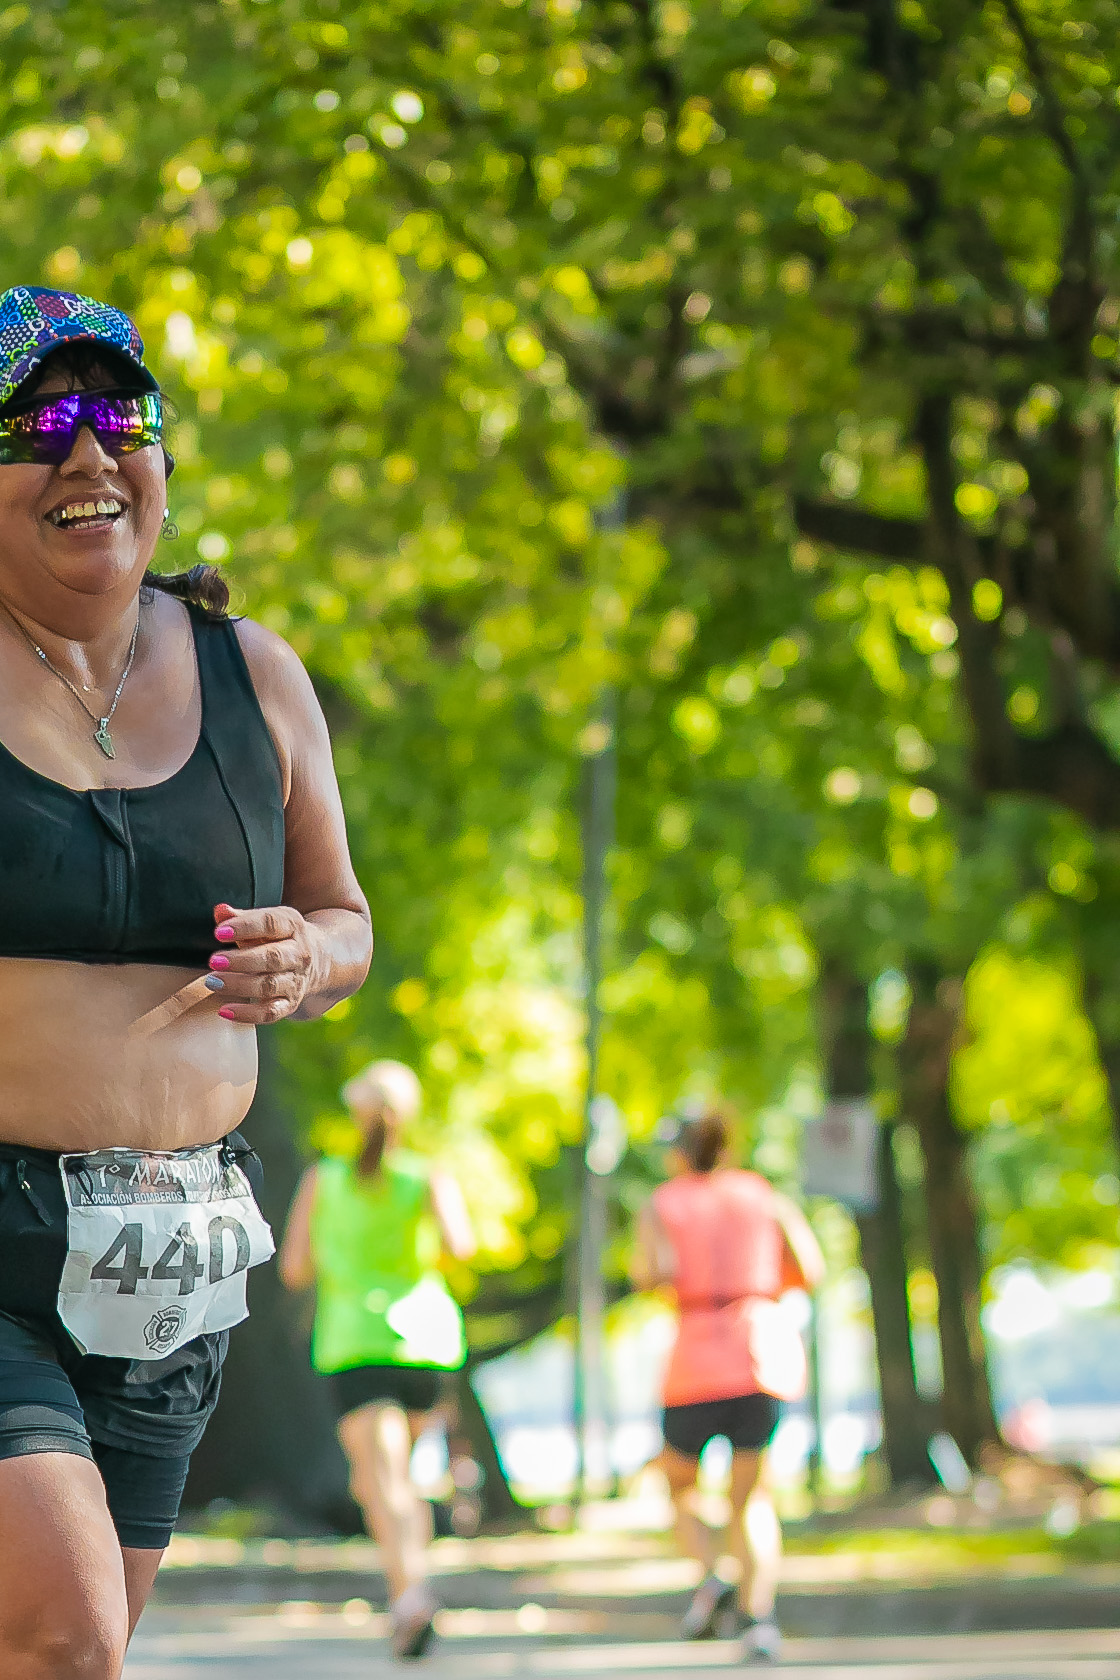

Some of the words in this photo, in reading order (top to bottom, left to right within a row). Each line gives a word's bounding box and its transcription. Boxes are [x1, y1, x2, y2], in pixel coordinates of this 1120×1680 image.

[134, 1190, 183, 1204] BOMBEROS
[90, 1215, 251, 1296] 440
[159, 1320, 179, 1337] 27
